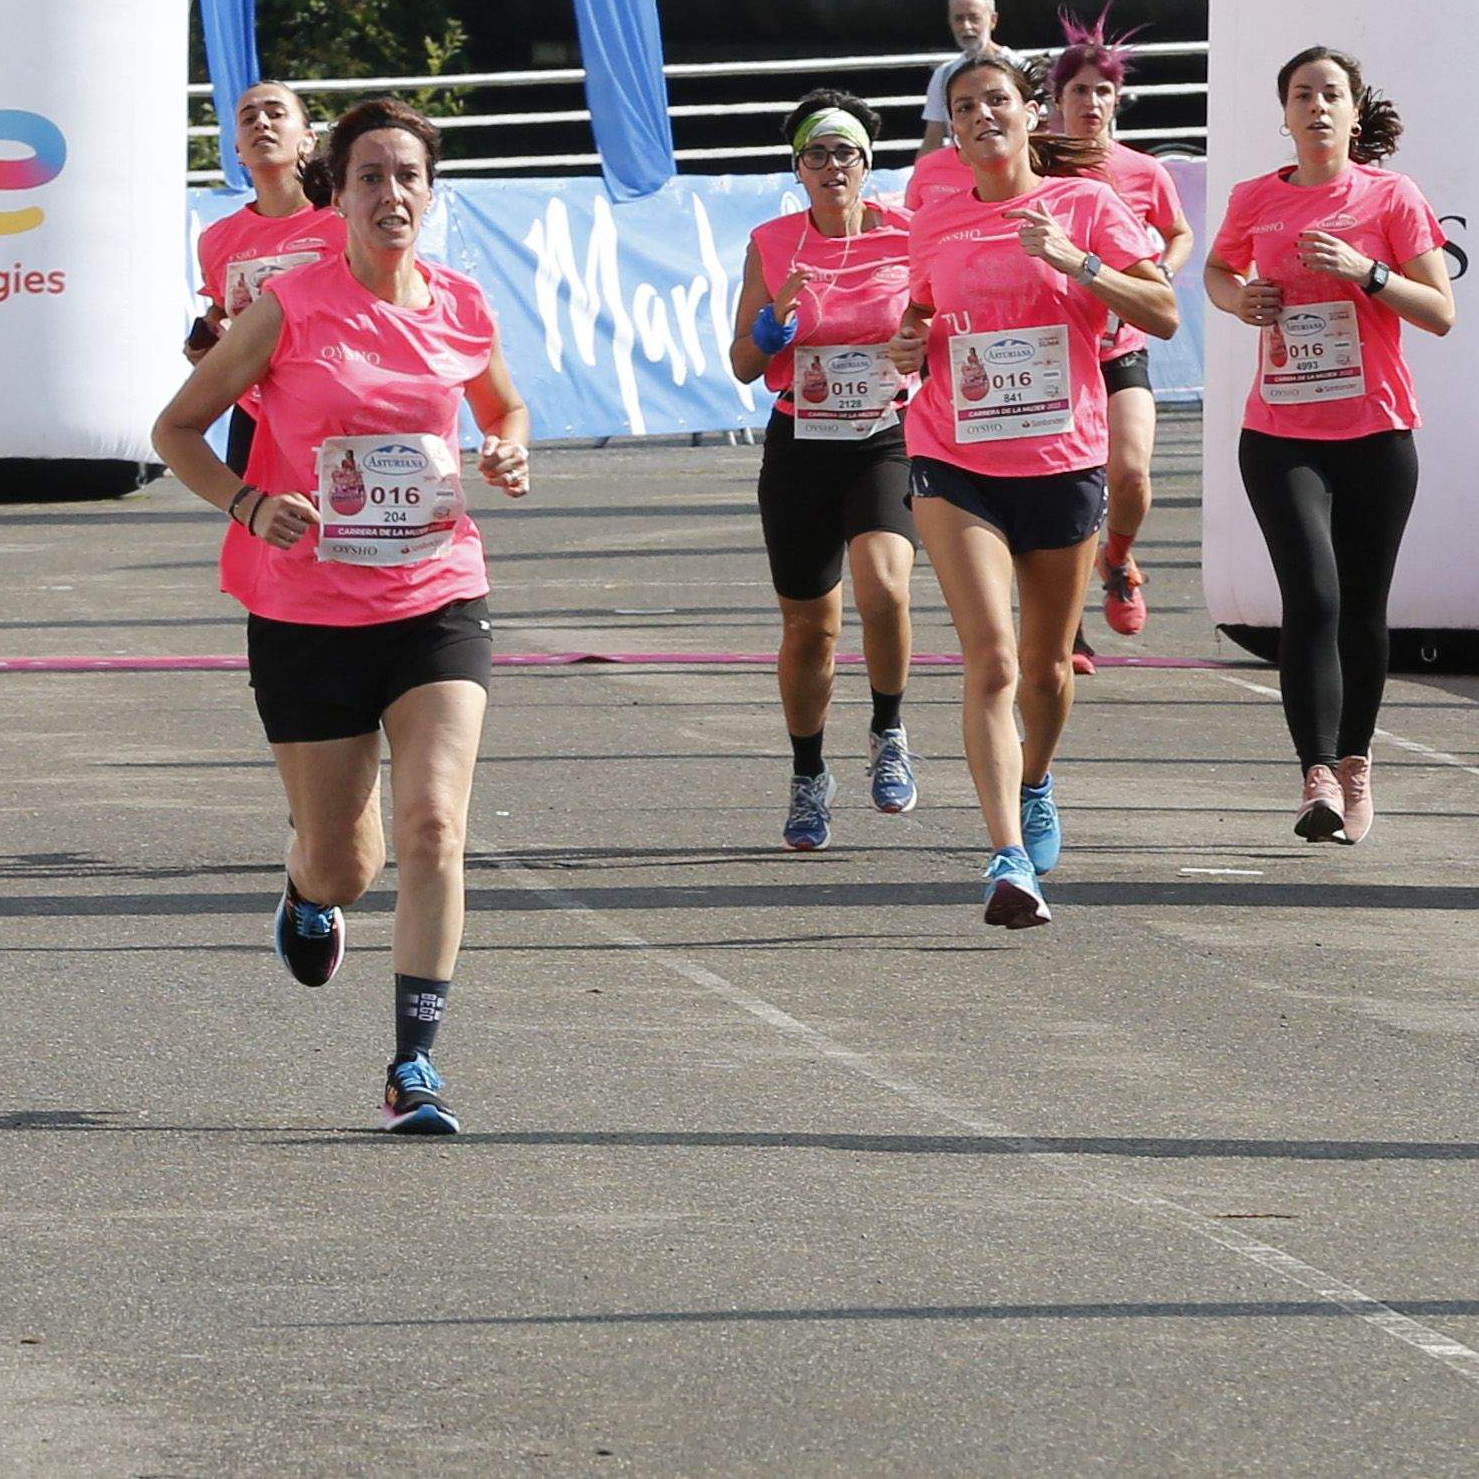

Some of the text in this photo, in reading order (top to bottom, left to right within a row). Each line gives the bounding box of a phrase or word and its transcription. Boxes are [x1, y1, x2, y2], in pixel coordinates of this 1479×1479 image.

[1289, 343, 1323, 358] 016
[993, 372, 1032, 389] 016
[832, 381, 868, 395] 016
[839, 399, 862, 408] 2128
[1004, 393, 1023, 403] 841
[368, 456, 423, 468] ASTURIANA
[371, 487, 420, 504] 016
[383, 511, 407, 523] 204
[338, 528, 379, 536] CARRERA
[380, 528, 392, 536] DE
[333, 544, 378, 556] OYSHO
